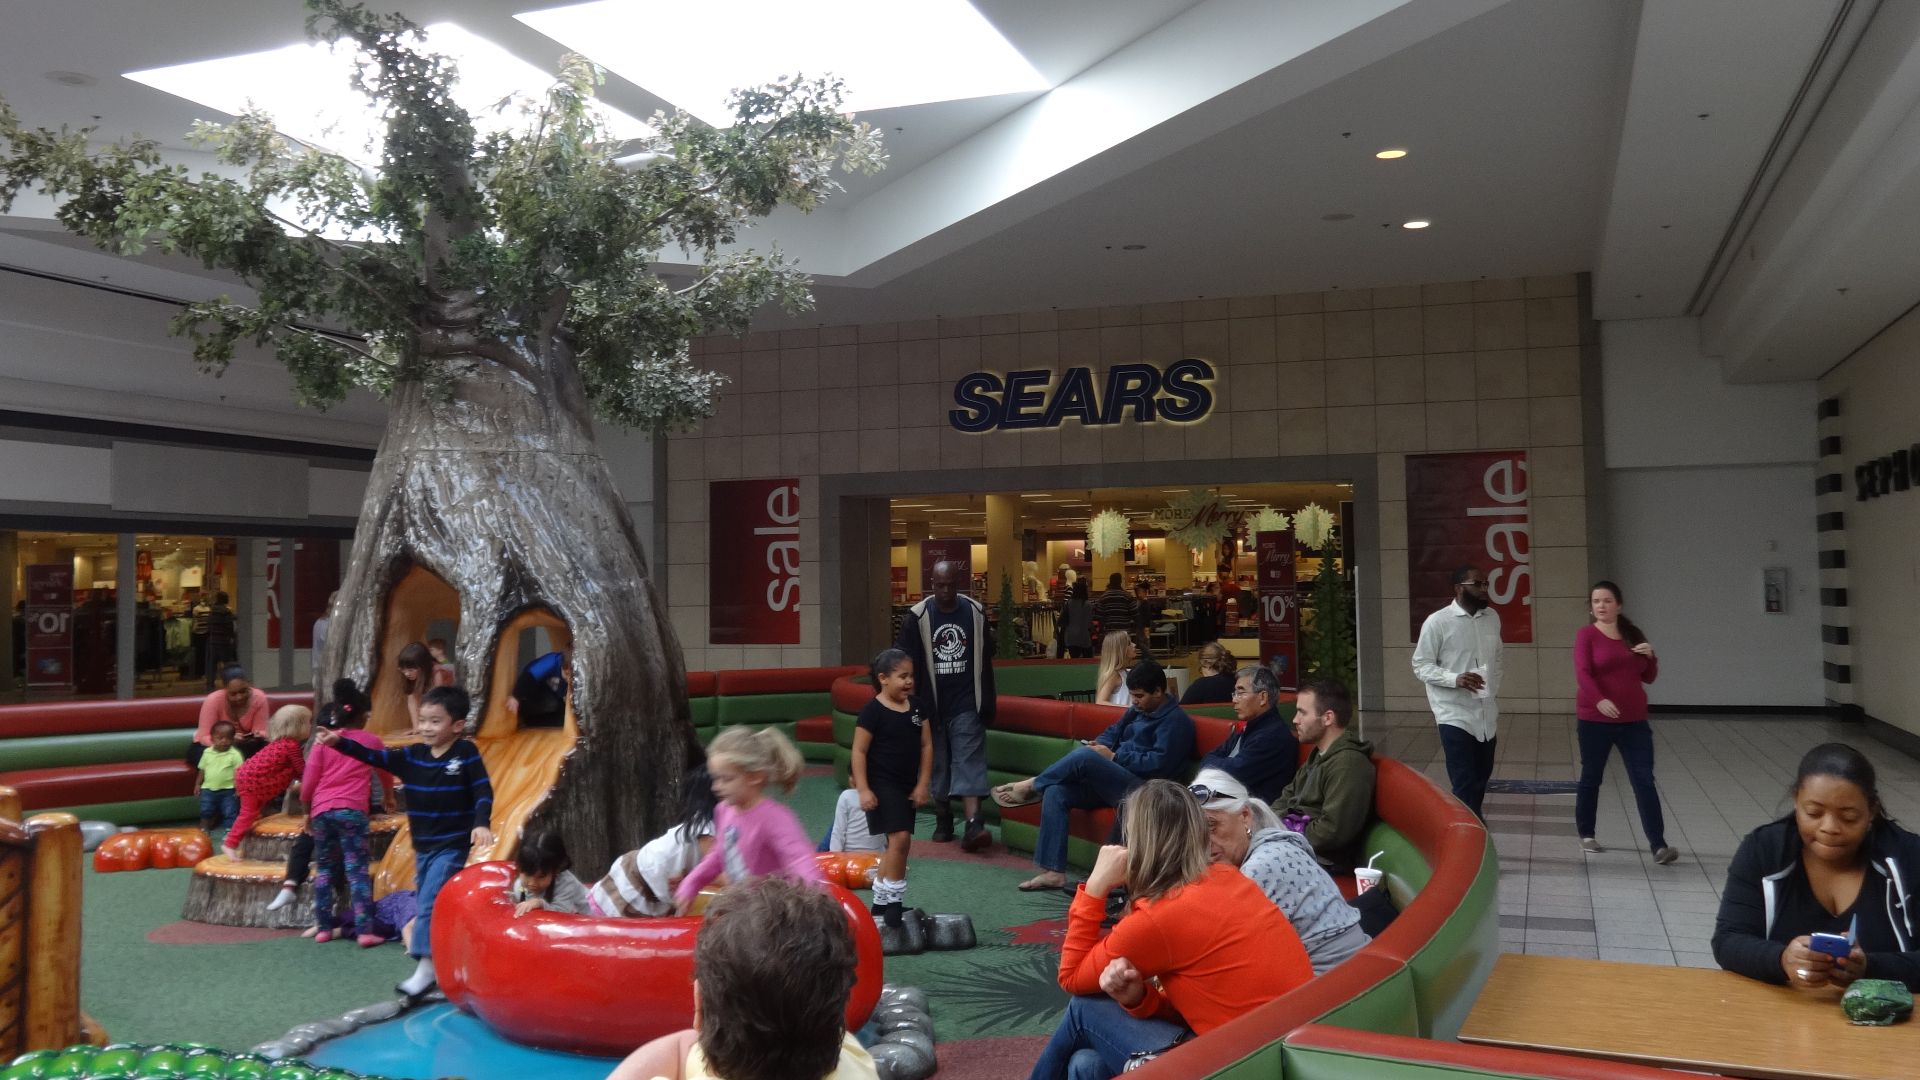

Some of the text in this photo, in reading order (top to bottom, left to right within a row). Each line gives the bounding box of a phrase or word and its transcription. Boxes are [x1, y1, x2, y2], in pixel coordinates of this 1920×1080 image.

[949, 359, 1215, 432] SEARS
[1153, 502, 1246, 531] MORE Merry
[1467, 459, 1531, 605] sale
[754, 486, 800, 612] sale
[1260, 549, 1293, 567] Merry
[1261, 596, 1294, 622] 10%
[933, 648, 952, 661] STRIKE
